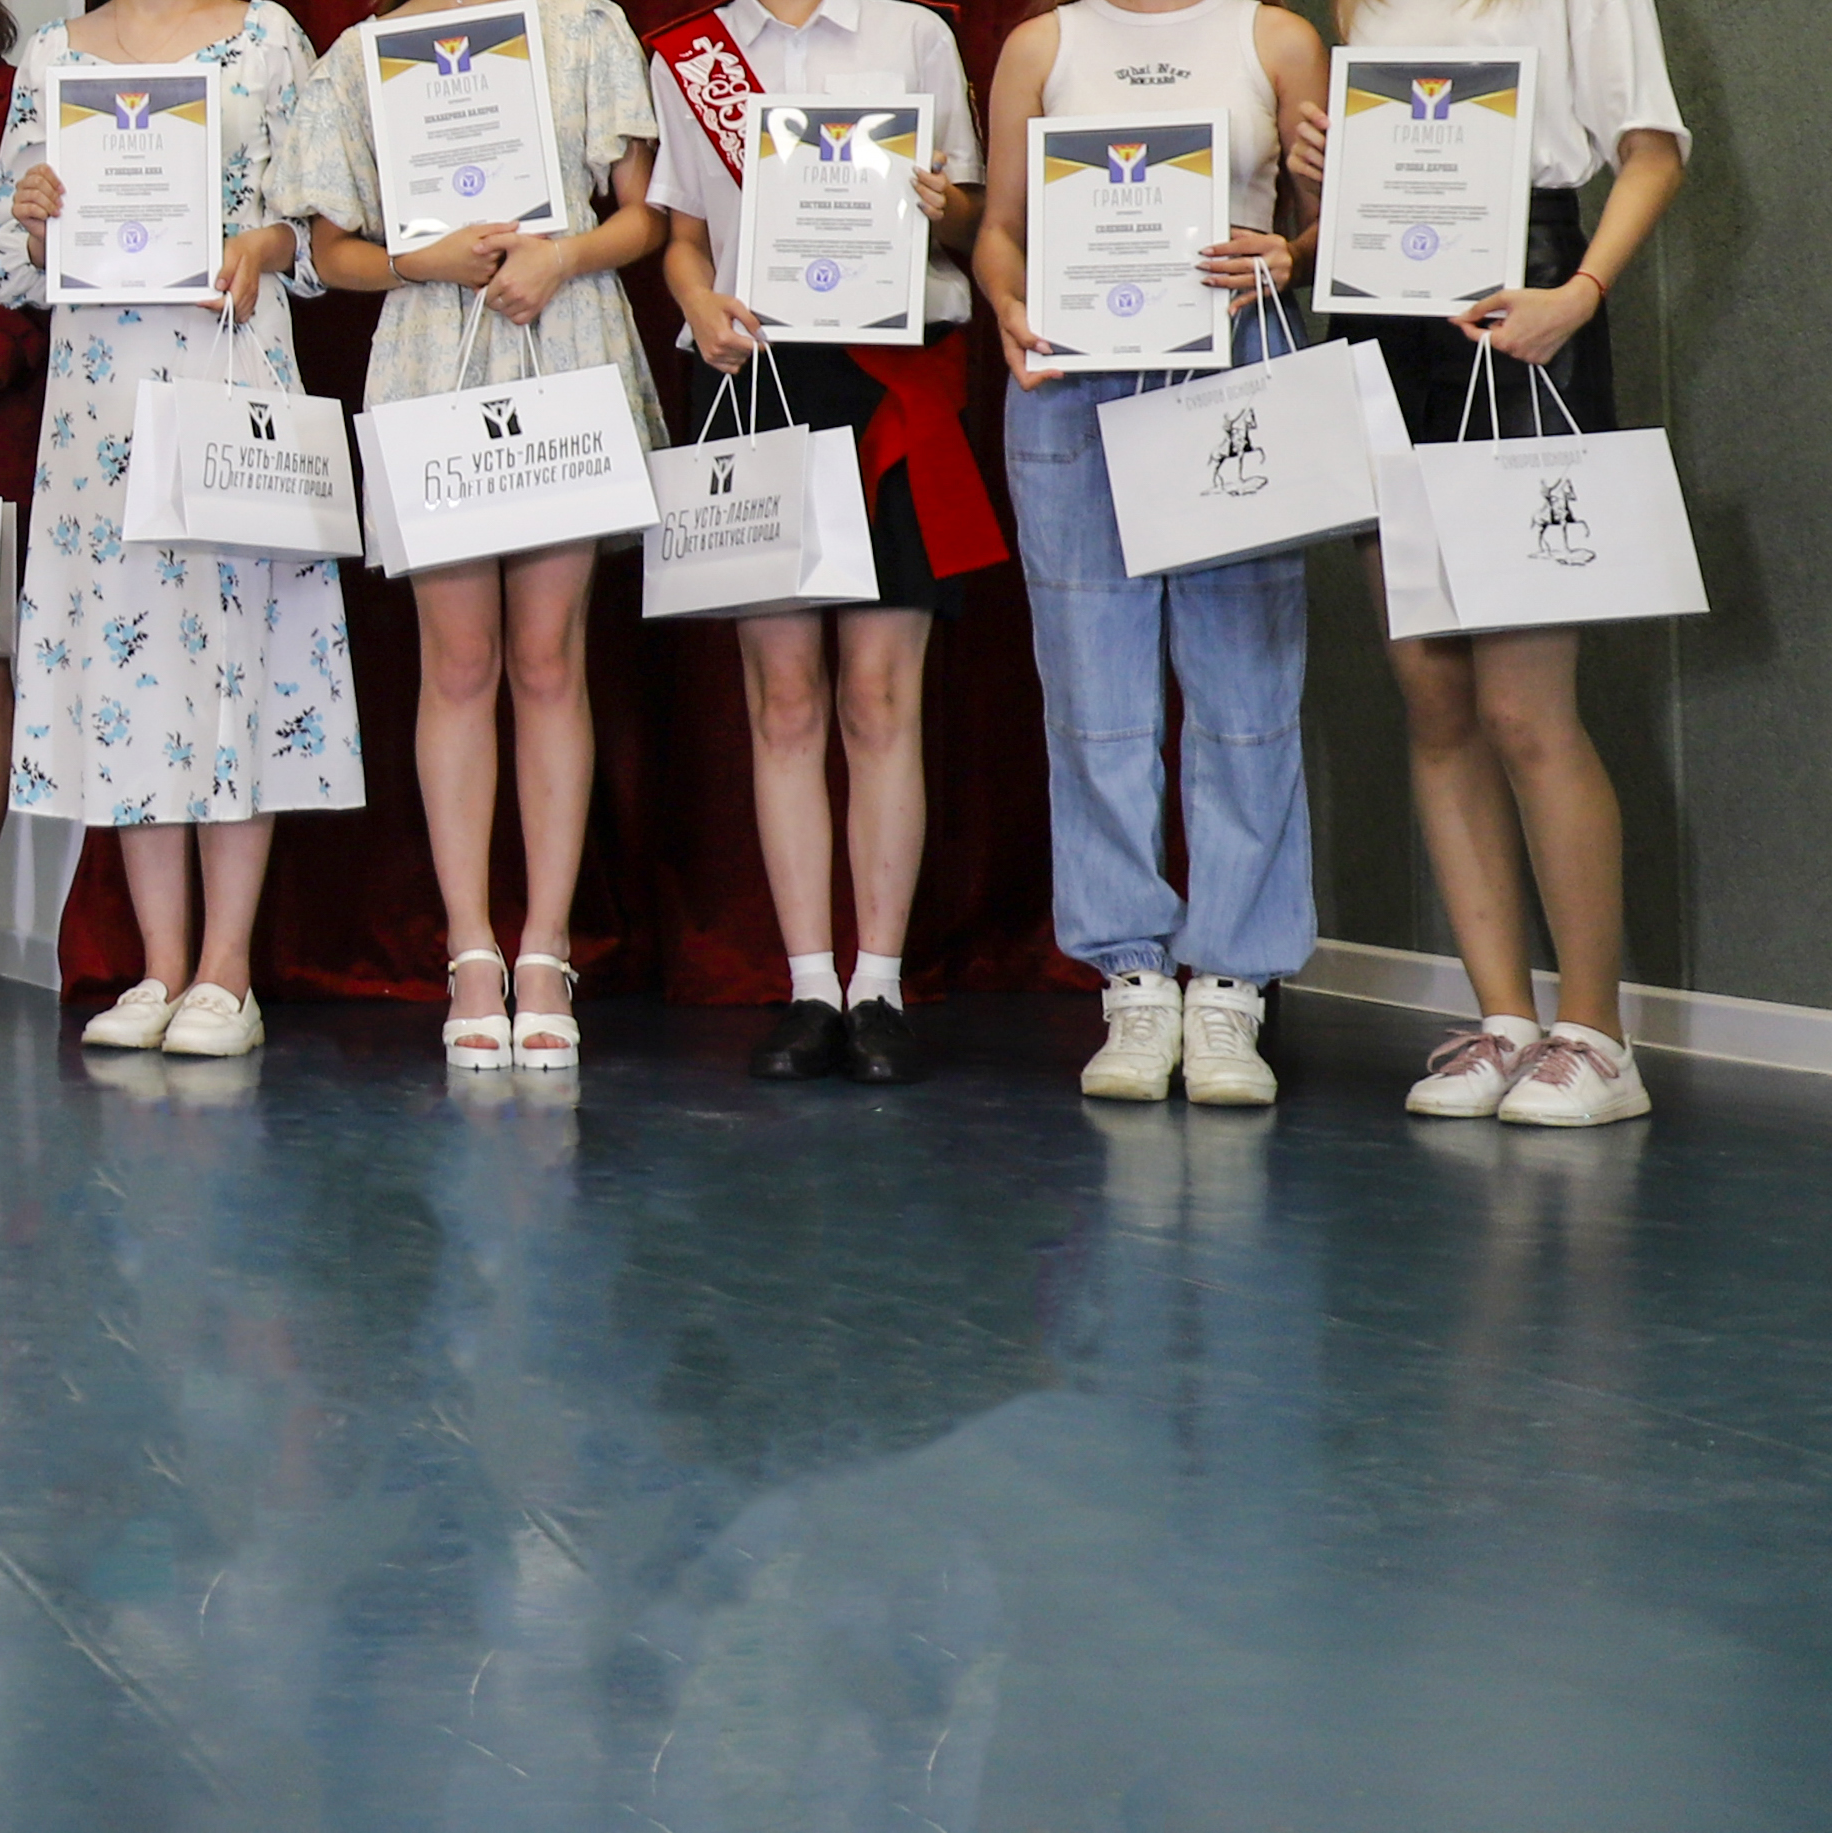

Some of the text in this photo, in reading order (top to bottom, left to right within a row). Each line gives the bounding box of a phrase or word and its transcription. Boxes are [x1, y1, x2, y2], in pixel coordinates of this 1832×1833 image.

[426, 73, 489, 99] ГРАМОТА
[102, 133, 164, 151] ГРАМОТА
[1393, 125, 1464, 145] ГРАМОТА
[1093, 187, 1163, 208] ГРАМОТА
[203, 443, 233, 490] 65
[240, 446, 329, 477] УСТЬ-ЛАБИНСК
[472, 430, 603, 474] УСТЬ-ЛАБИНСК
[425, 456, 462, 510] 65
[499, 466, 556, 492] СТАТУСЕ
[562, 456, 612, 481] ГОРОДА
